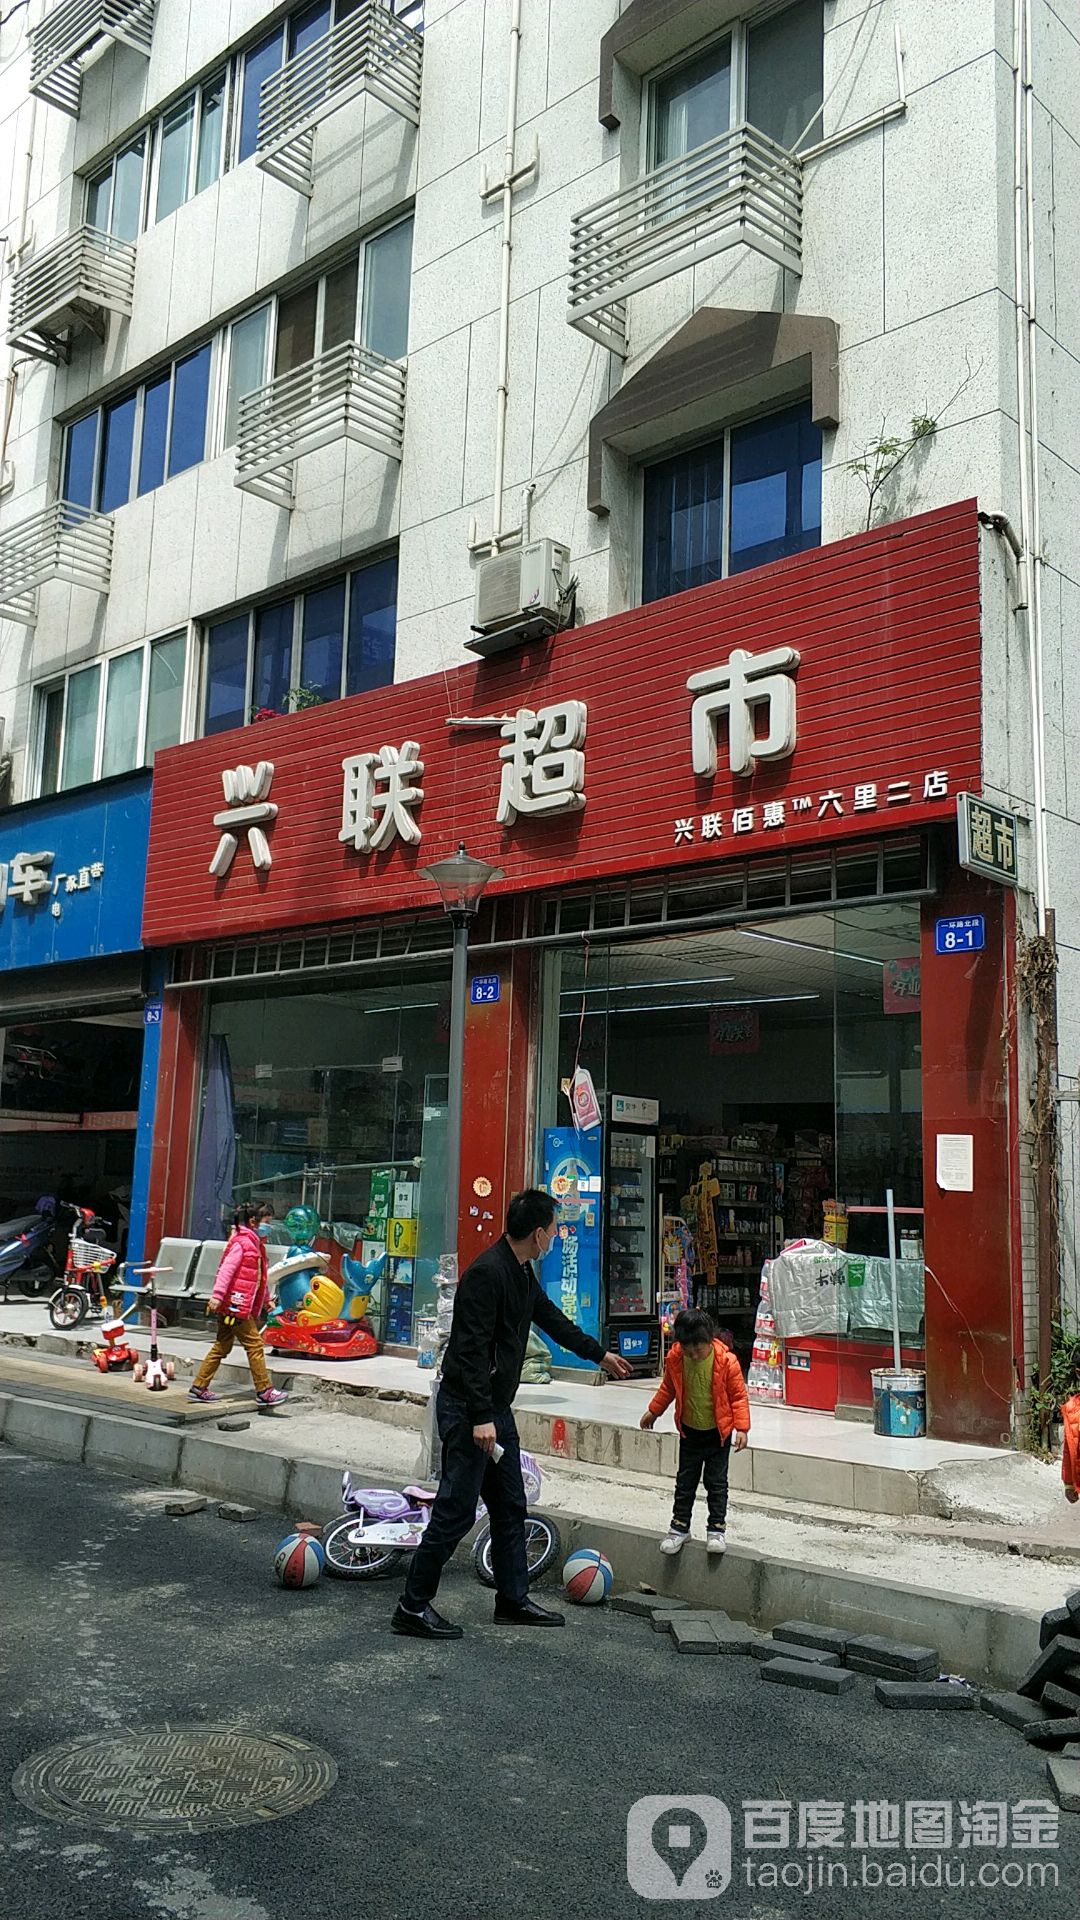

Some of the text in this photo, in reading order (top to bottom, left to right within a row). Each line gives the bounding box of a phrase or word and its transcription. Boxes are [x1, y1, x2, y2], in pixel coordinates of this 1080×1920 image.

[208, 646, 802, 878] 兴联超市
[971, 805, 1014, 870] 超市
[0, 851, 55, 912] 车
[941, 919, 980, 929] 一环路北段
[944, 929, 974, 949] 8-1
[476, 985, 495, 1000] 8-2
[147, 1010, 160, 1022] 8-3
